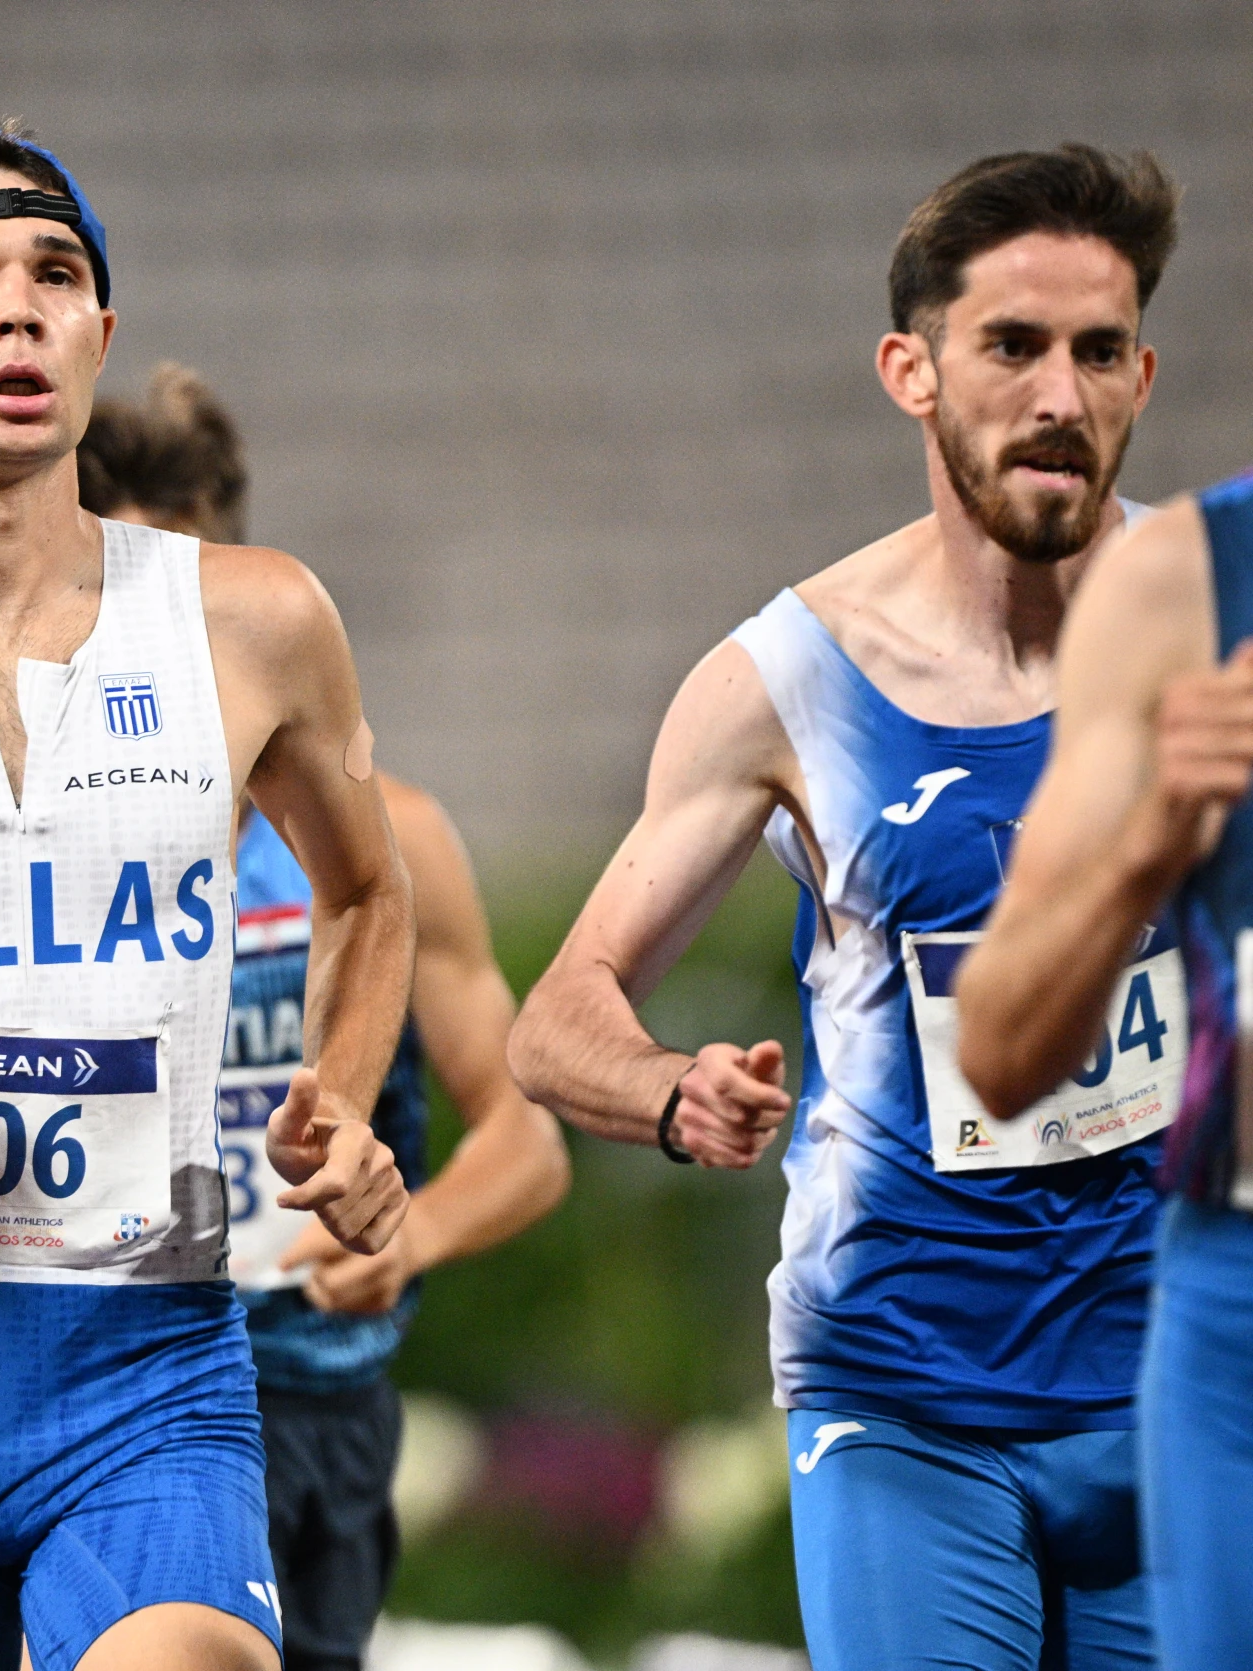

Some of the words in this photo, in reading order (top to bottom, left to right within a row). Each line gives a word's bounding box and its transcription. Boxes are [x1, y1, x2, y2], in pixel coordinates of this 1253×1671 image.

[111, 678, 142, 687] ΕΛΛΑΣ
[64, 767, 189, 792] AEGEAN
[1075, 1102, 1113, 1119] BALKAN
[1115, 1083, 1158, 1107] ATHLETICS
[1079, 1116, 1126, 1139] VOLOS
[1128, 1101, 1163, 1123] 2026
[13, 1216, 64, 1227] ATHLETICS
[23, 1235, 64, 1248] 2026
